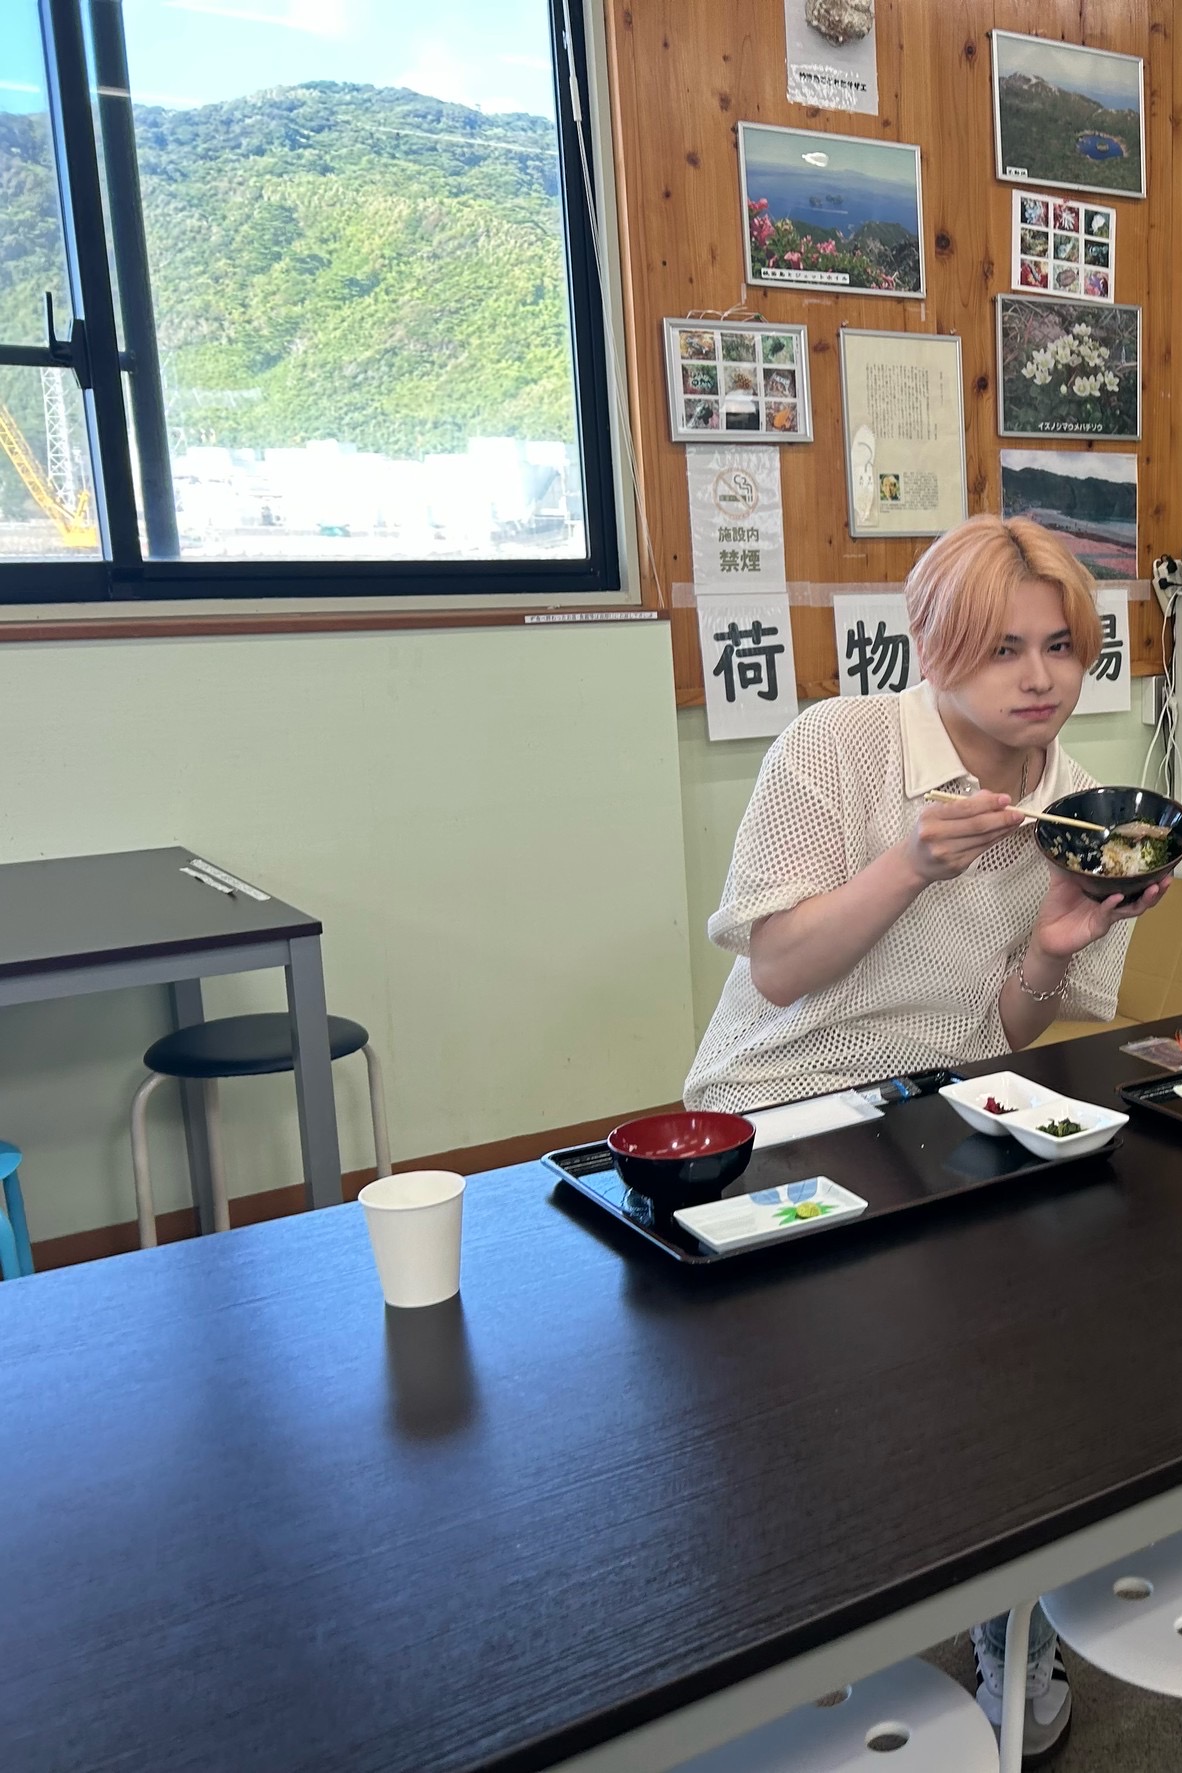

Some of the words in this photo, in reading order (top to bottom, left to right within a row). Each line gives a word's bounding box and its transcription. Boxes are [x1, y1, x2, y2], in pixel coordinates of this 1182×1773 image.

[718, 526, 760, 543] 施設内
[719, 549, 762, 573] 禁煙
[713, 620, 785, 702] 荷
[846, 619, 910, 696] 物
